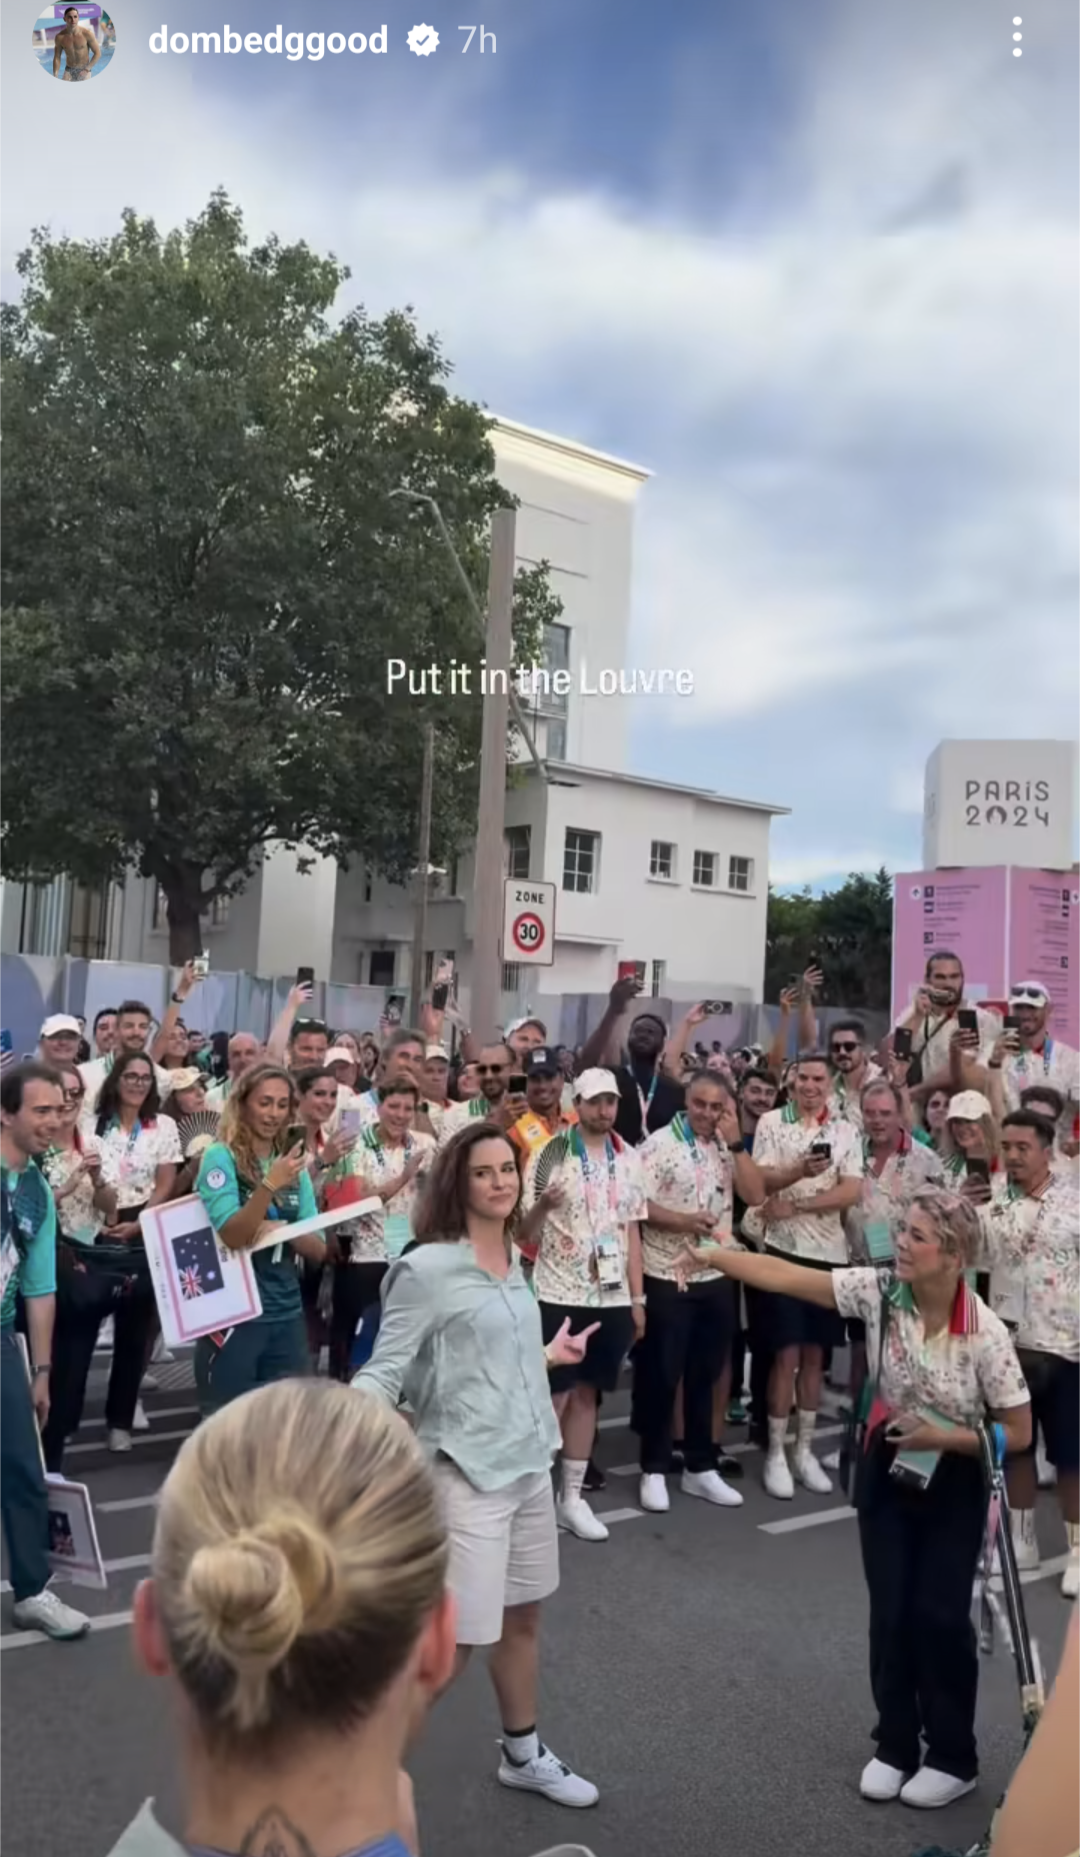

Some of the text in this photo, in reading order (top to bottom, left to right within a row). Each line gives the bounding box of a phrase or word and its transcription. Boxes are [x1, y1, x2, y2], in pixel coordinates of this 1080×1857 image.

[965, 805, 1049, 826] 2024
[515, 890, 545, 904] ZONE
[520, 923, 538, 941] 30
